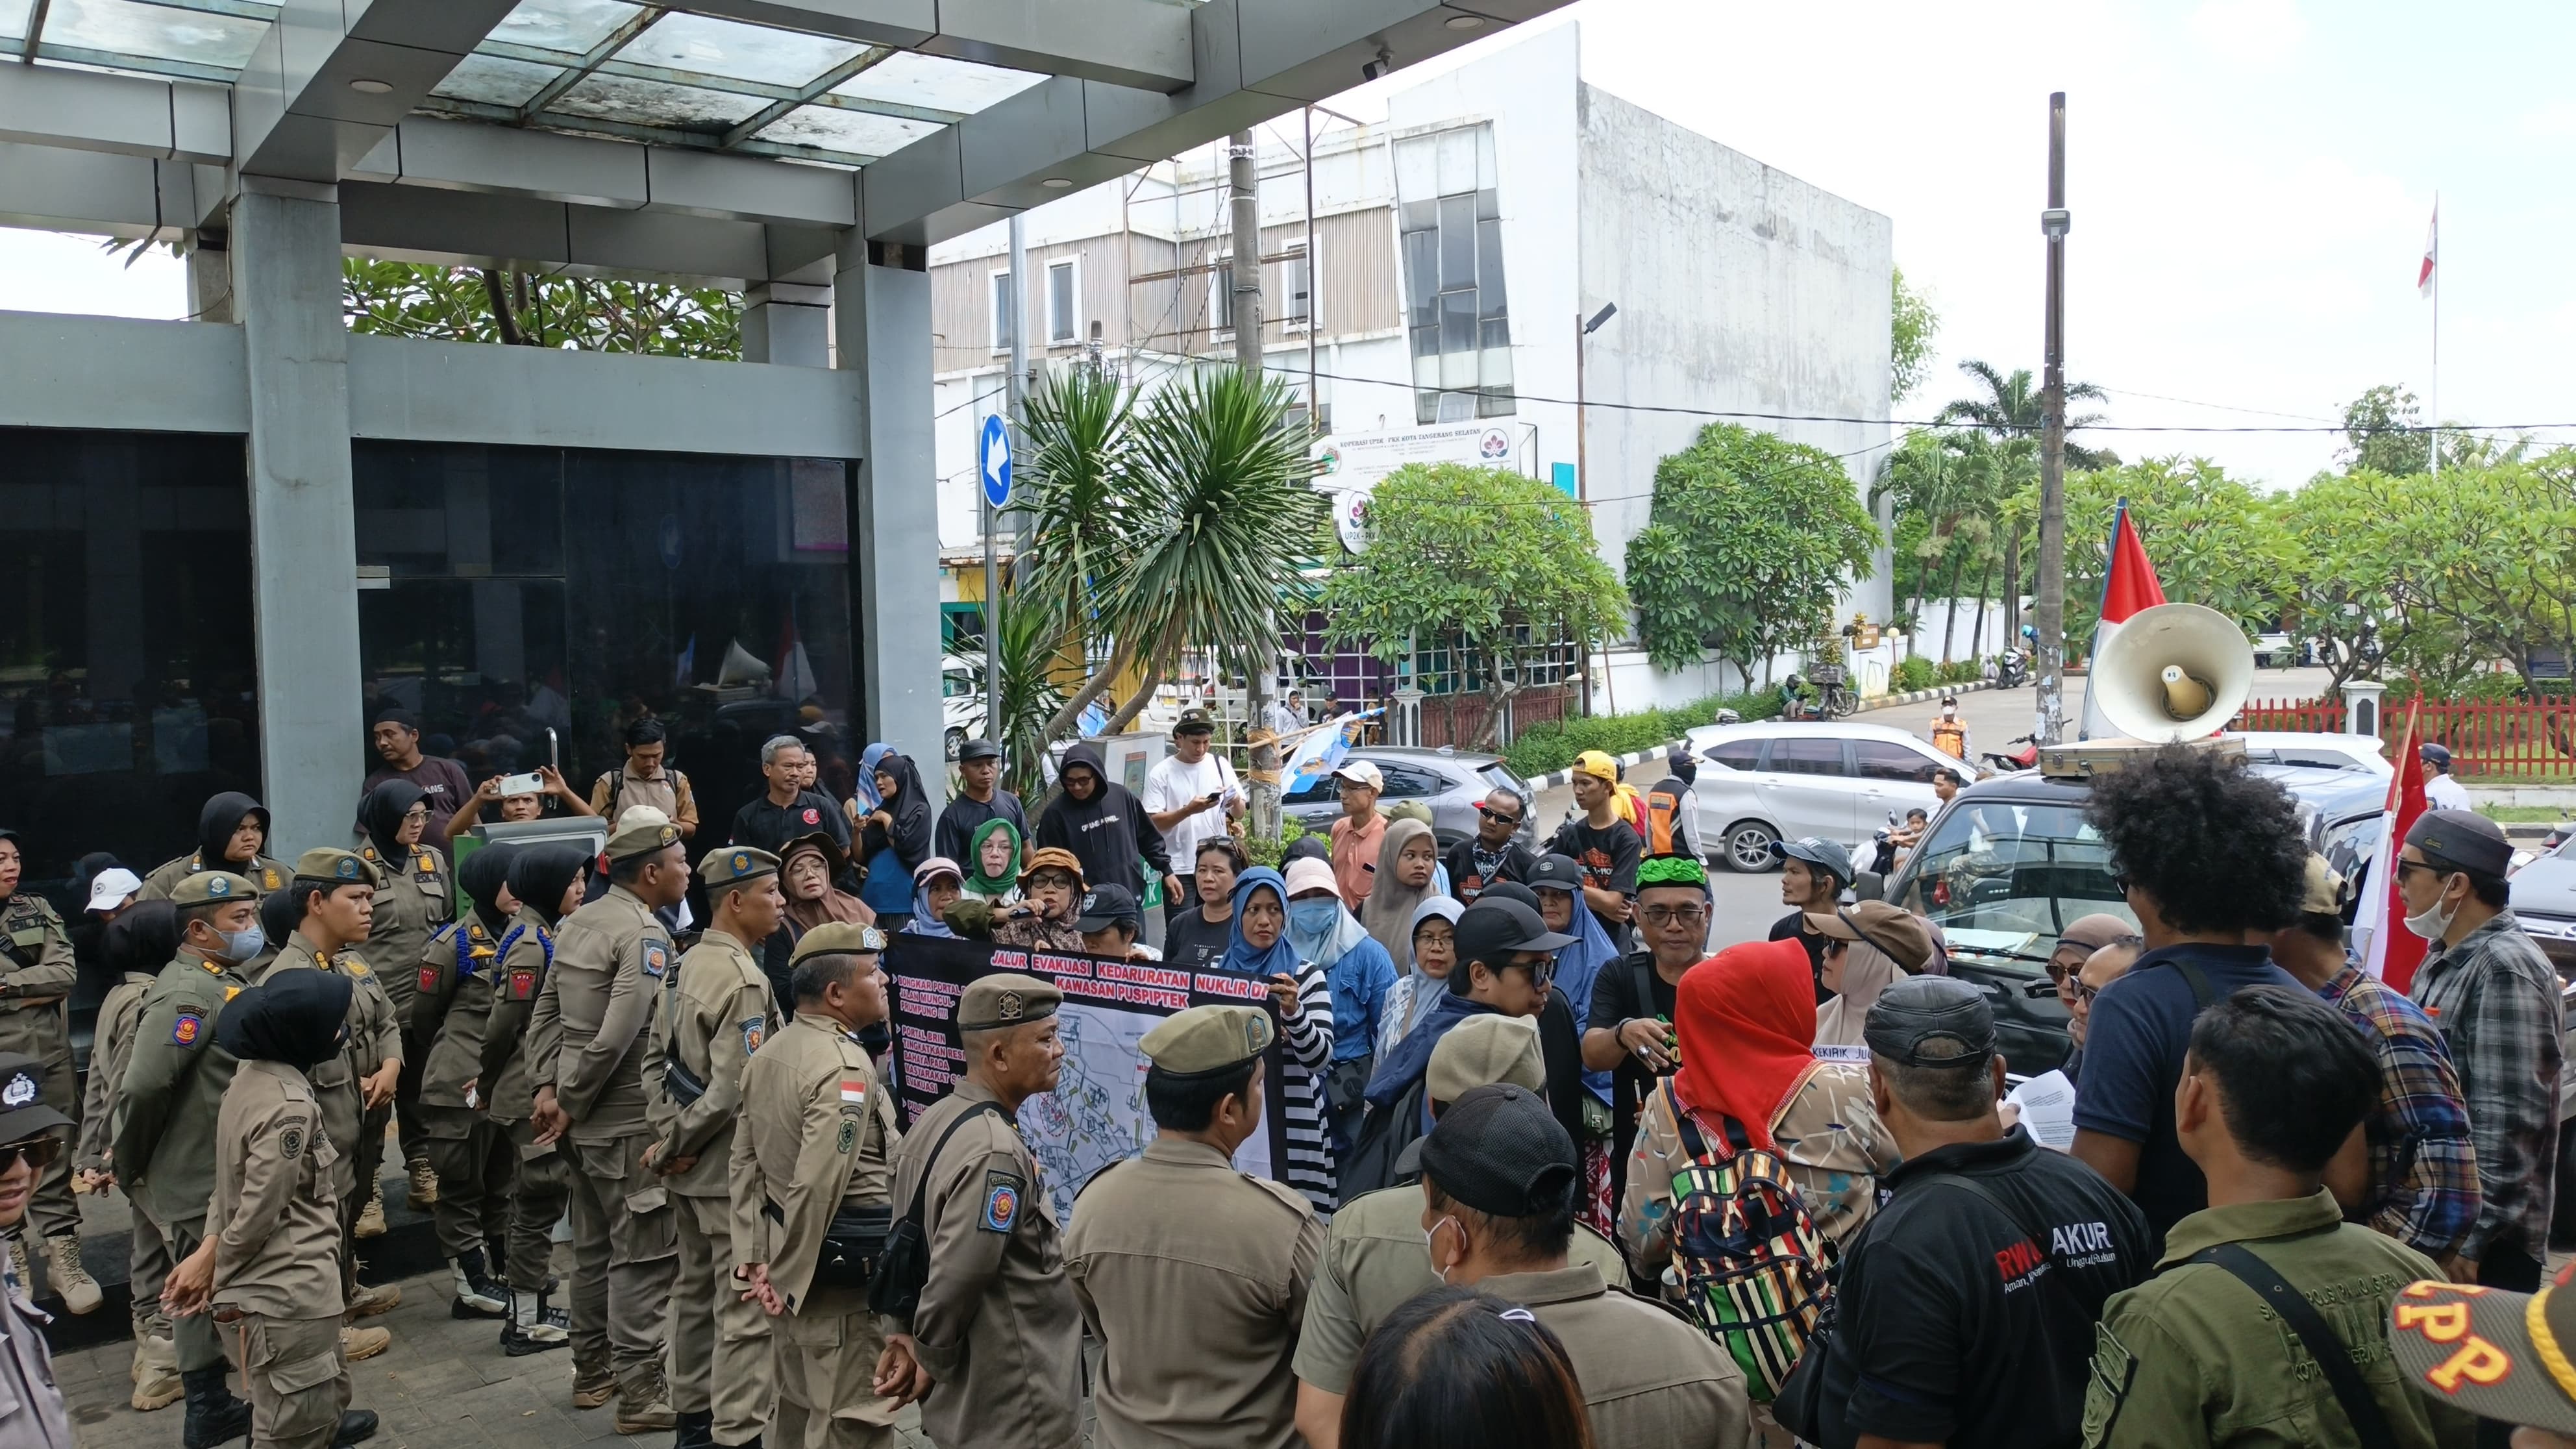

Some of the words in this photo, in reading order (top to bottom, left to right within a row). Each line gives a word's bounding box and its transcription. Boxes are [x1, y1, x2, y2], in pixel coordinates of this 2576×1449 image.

[1418, 431, 1453, 440] TANGERANG
[897, 974, 932, 992] BONGKAR
[932, 981, 961, 996] PORTAL
[991, 950, 1028, 969] JALUR
[1032, 954, 1092, 976] EVAKUASI
[1096, 961, 1191, 990] KEDARURATAN
[1195, 973, 1249, 998] NUKLIR
[1250, 982, 1269, 1000] DI
[899, 987, 920, 1002] JALAN
[1055, 976, 1115, 1000] KAWASAN
[1117, 984, 1189, 1010] PUSPIPTEK
[900, 1000, 937, 1018] PRUMPUNG
[902, 1024, 927, 1041] PORTAL
[926, 1030, 946, 1045] BRIN
[902, 1037, 947, 1058] TINGKATKAN
[904, 1050, 929, 1067] BAHAYA
[929, 1056, 950, 1071] PADA
[904, 1062, 950, 1084] MASYARAKAT
[906, 1074, 939, 1094] EVAKUASI
[2051, 1222, 2114, 1256] AKUR
[2004, 1276, 2029, 1294] Aman,
